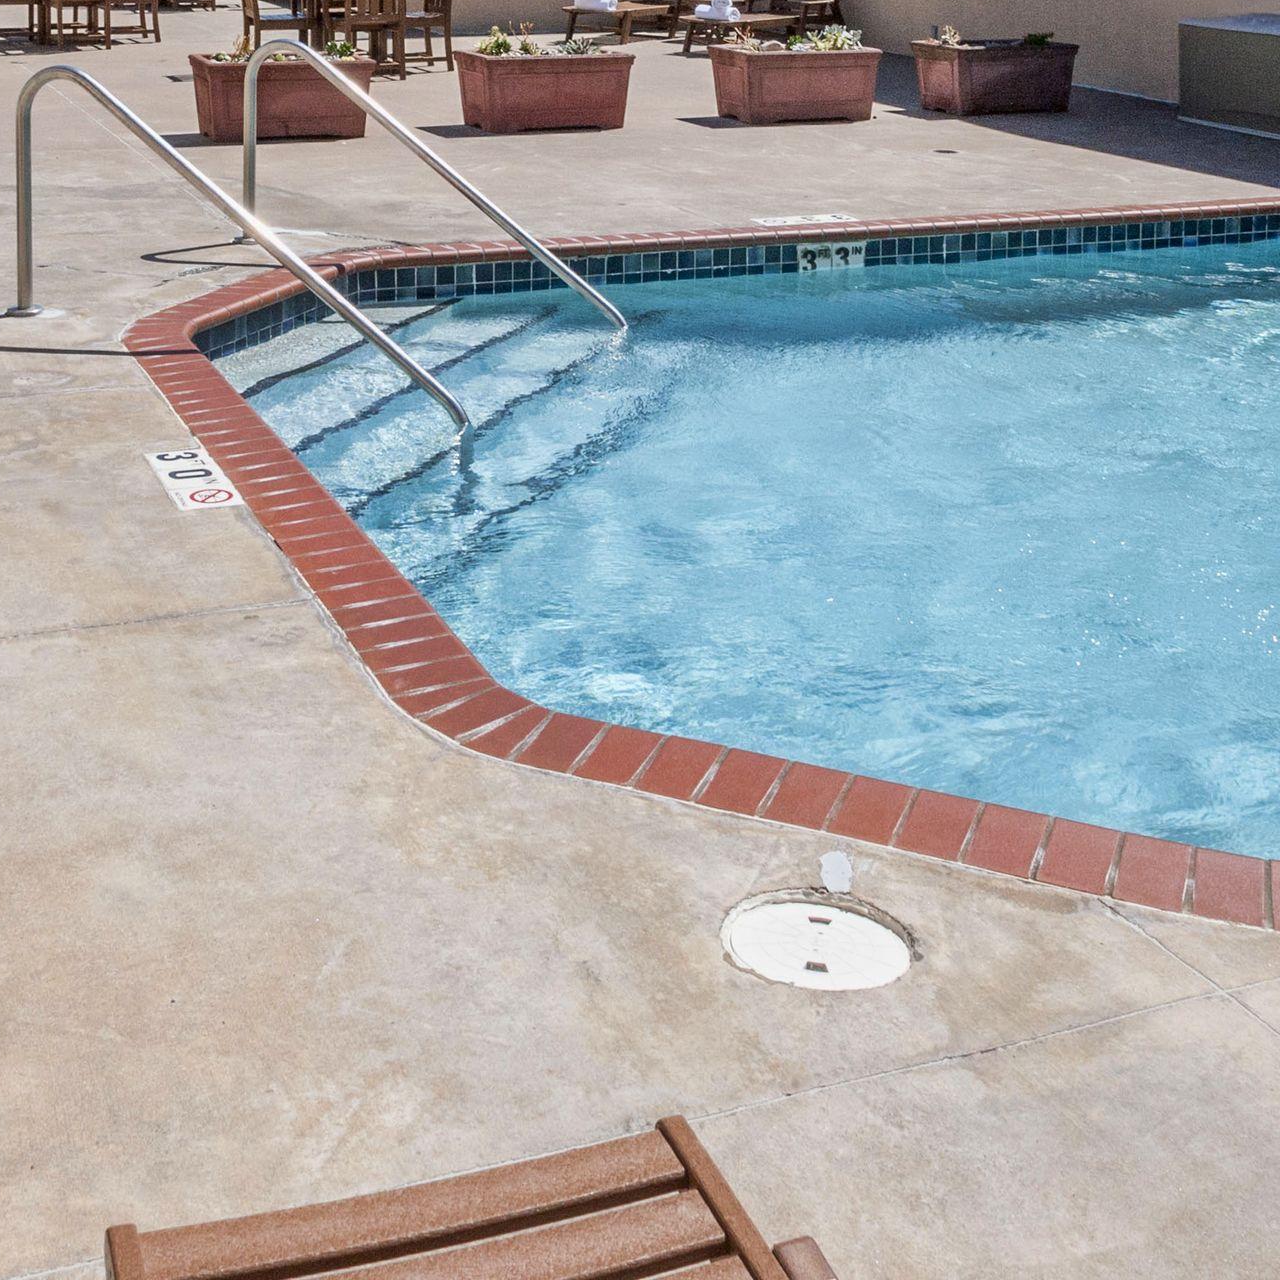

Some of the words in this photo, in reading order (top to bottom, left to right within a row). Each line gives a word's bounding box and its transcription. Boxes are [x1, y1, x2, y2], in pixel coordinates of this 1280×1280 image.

[801, 249, 817, 271] 3
[818, 248, 831, 258] FT
[851, 246, 863, 255] IN
[156, 452, 199, 462] 3
[168, 468, 213, 480] 0
